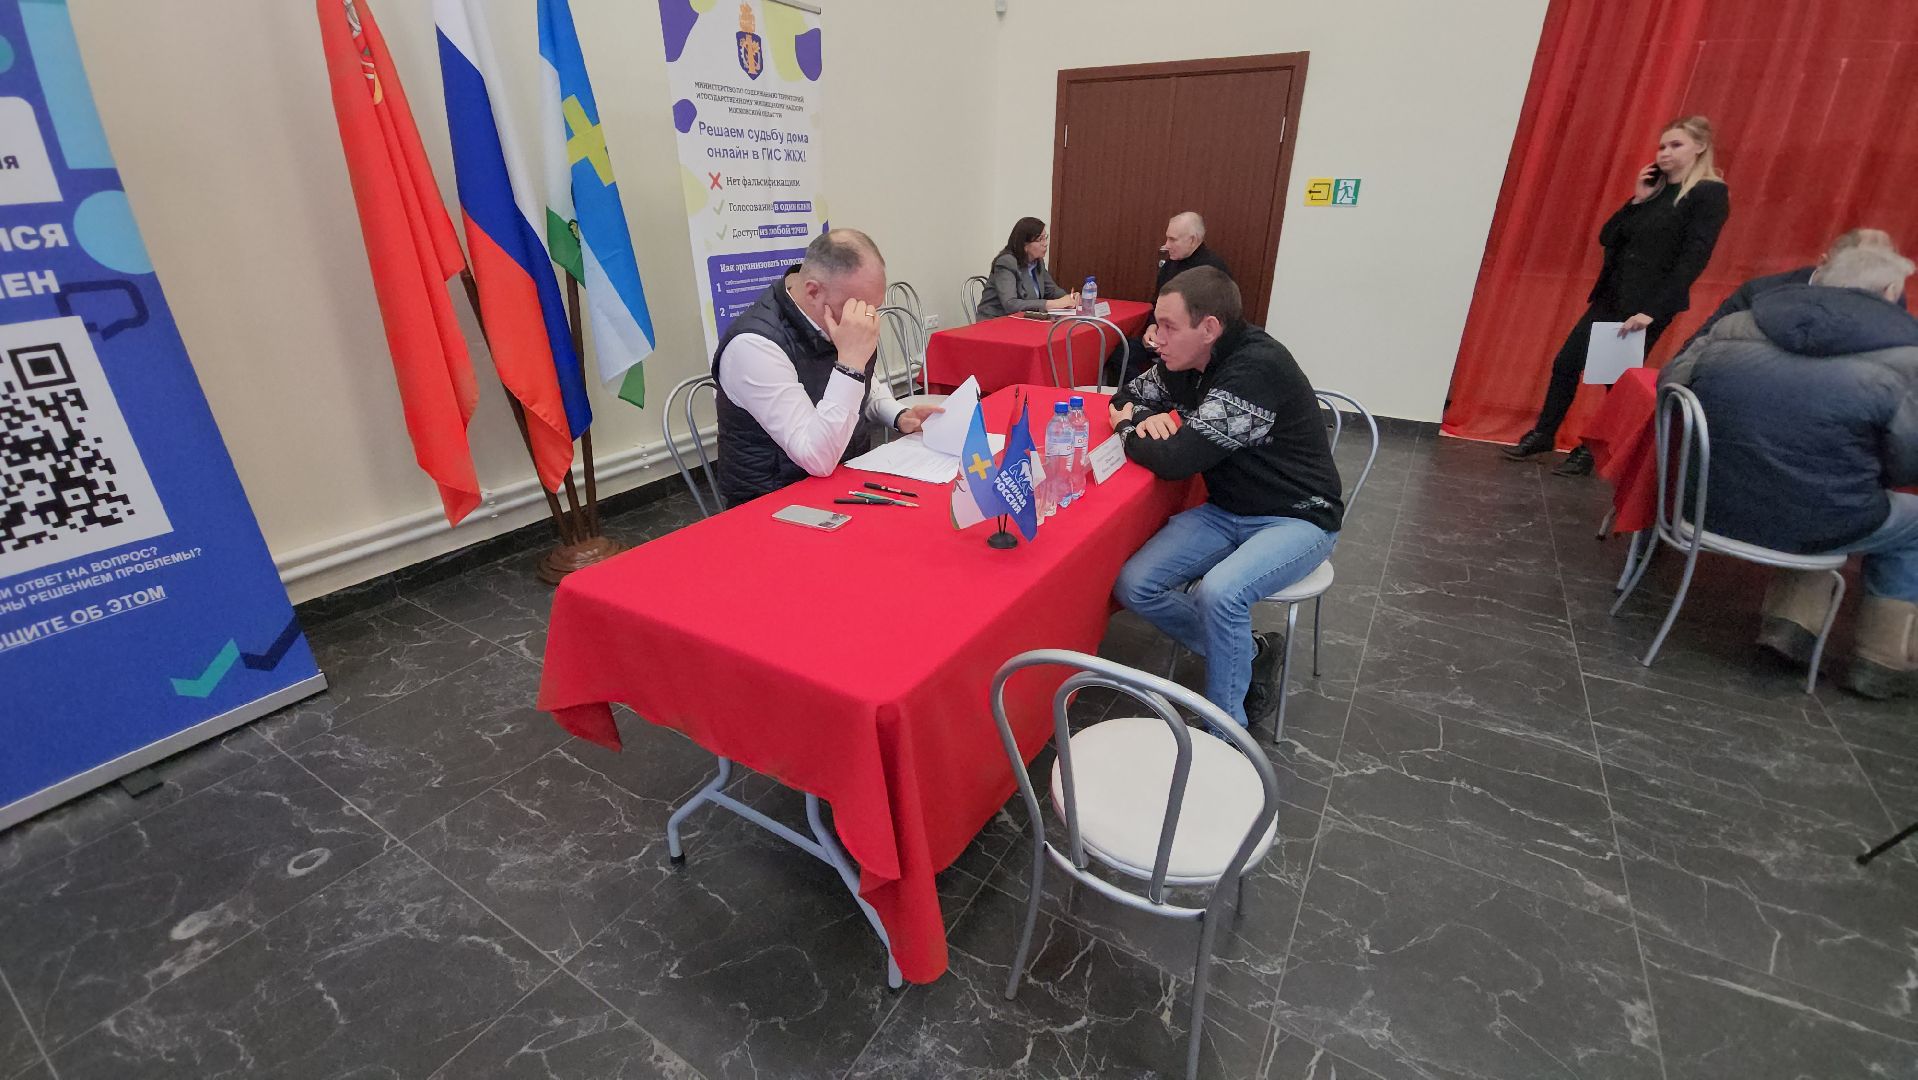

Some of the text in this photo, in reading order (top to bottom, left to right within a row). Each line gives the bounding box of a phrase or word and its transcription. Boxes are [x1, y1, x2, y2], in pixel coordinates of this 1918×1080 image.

[698, 121, 809, 144] Решаем судьбу дома
[707, 145, 807, 162] онлайн в ГИС ЖКХ!
[726, 177, 740, 186] Нет
[732, 228, 759, 239] Доступ
[720, 263, 736, 273] Как
[716, 282, 722, 293] 1
[719, 307, 726, 317] 2
[994, 476, 1022, 515] РОССИЯ
[1000, 469, 1027, 508] ЕДИНАЯ
[15, 572, 65, 594] ОТВЕТ
[67, 566, 89, 580] НА
[90, 546, 158, 573] ВОПРОС?
[30, 572, 114, 605] РЕШЕНИЕМ
[116, 547, 202, 579] ПРОБЛЕМЫ?
[70, 604, 104, 625] ОБ
[106, 585, 167, 613] ЭТОМ
